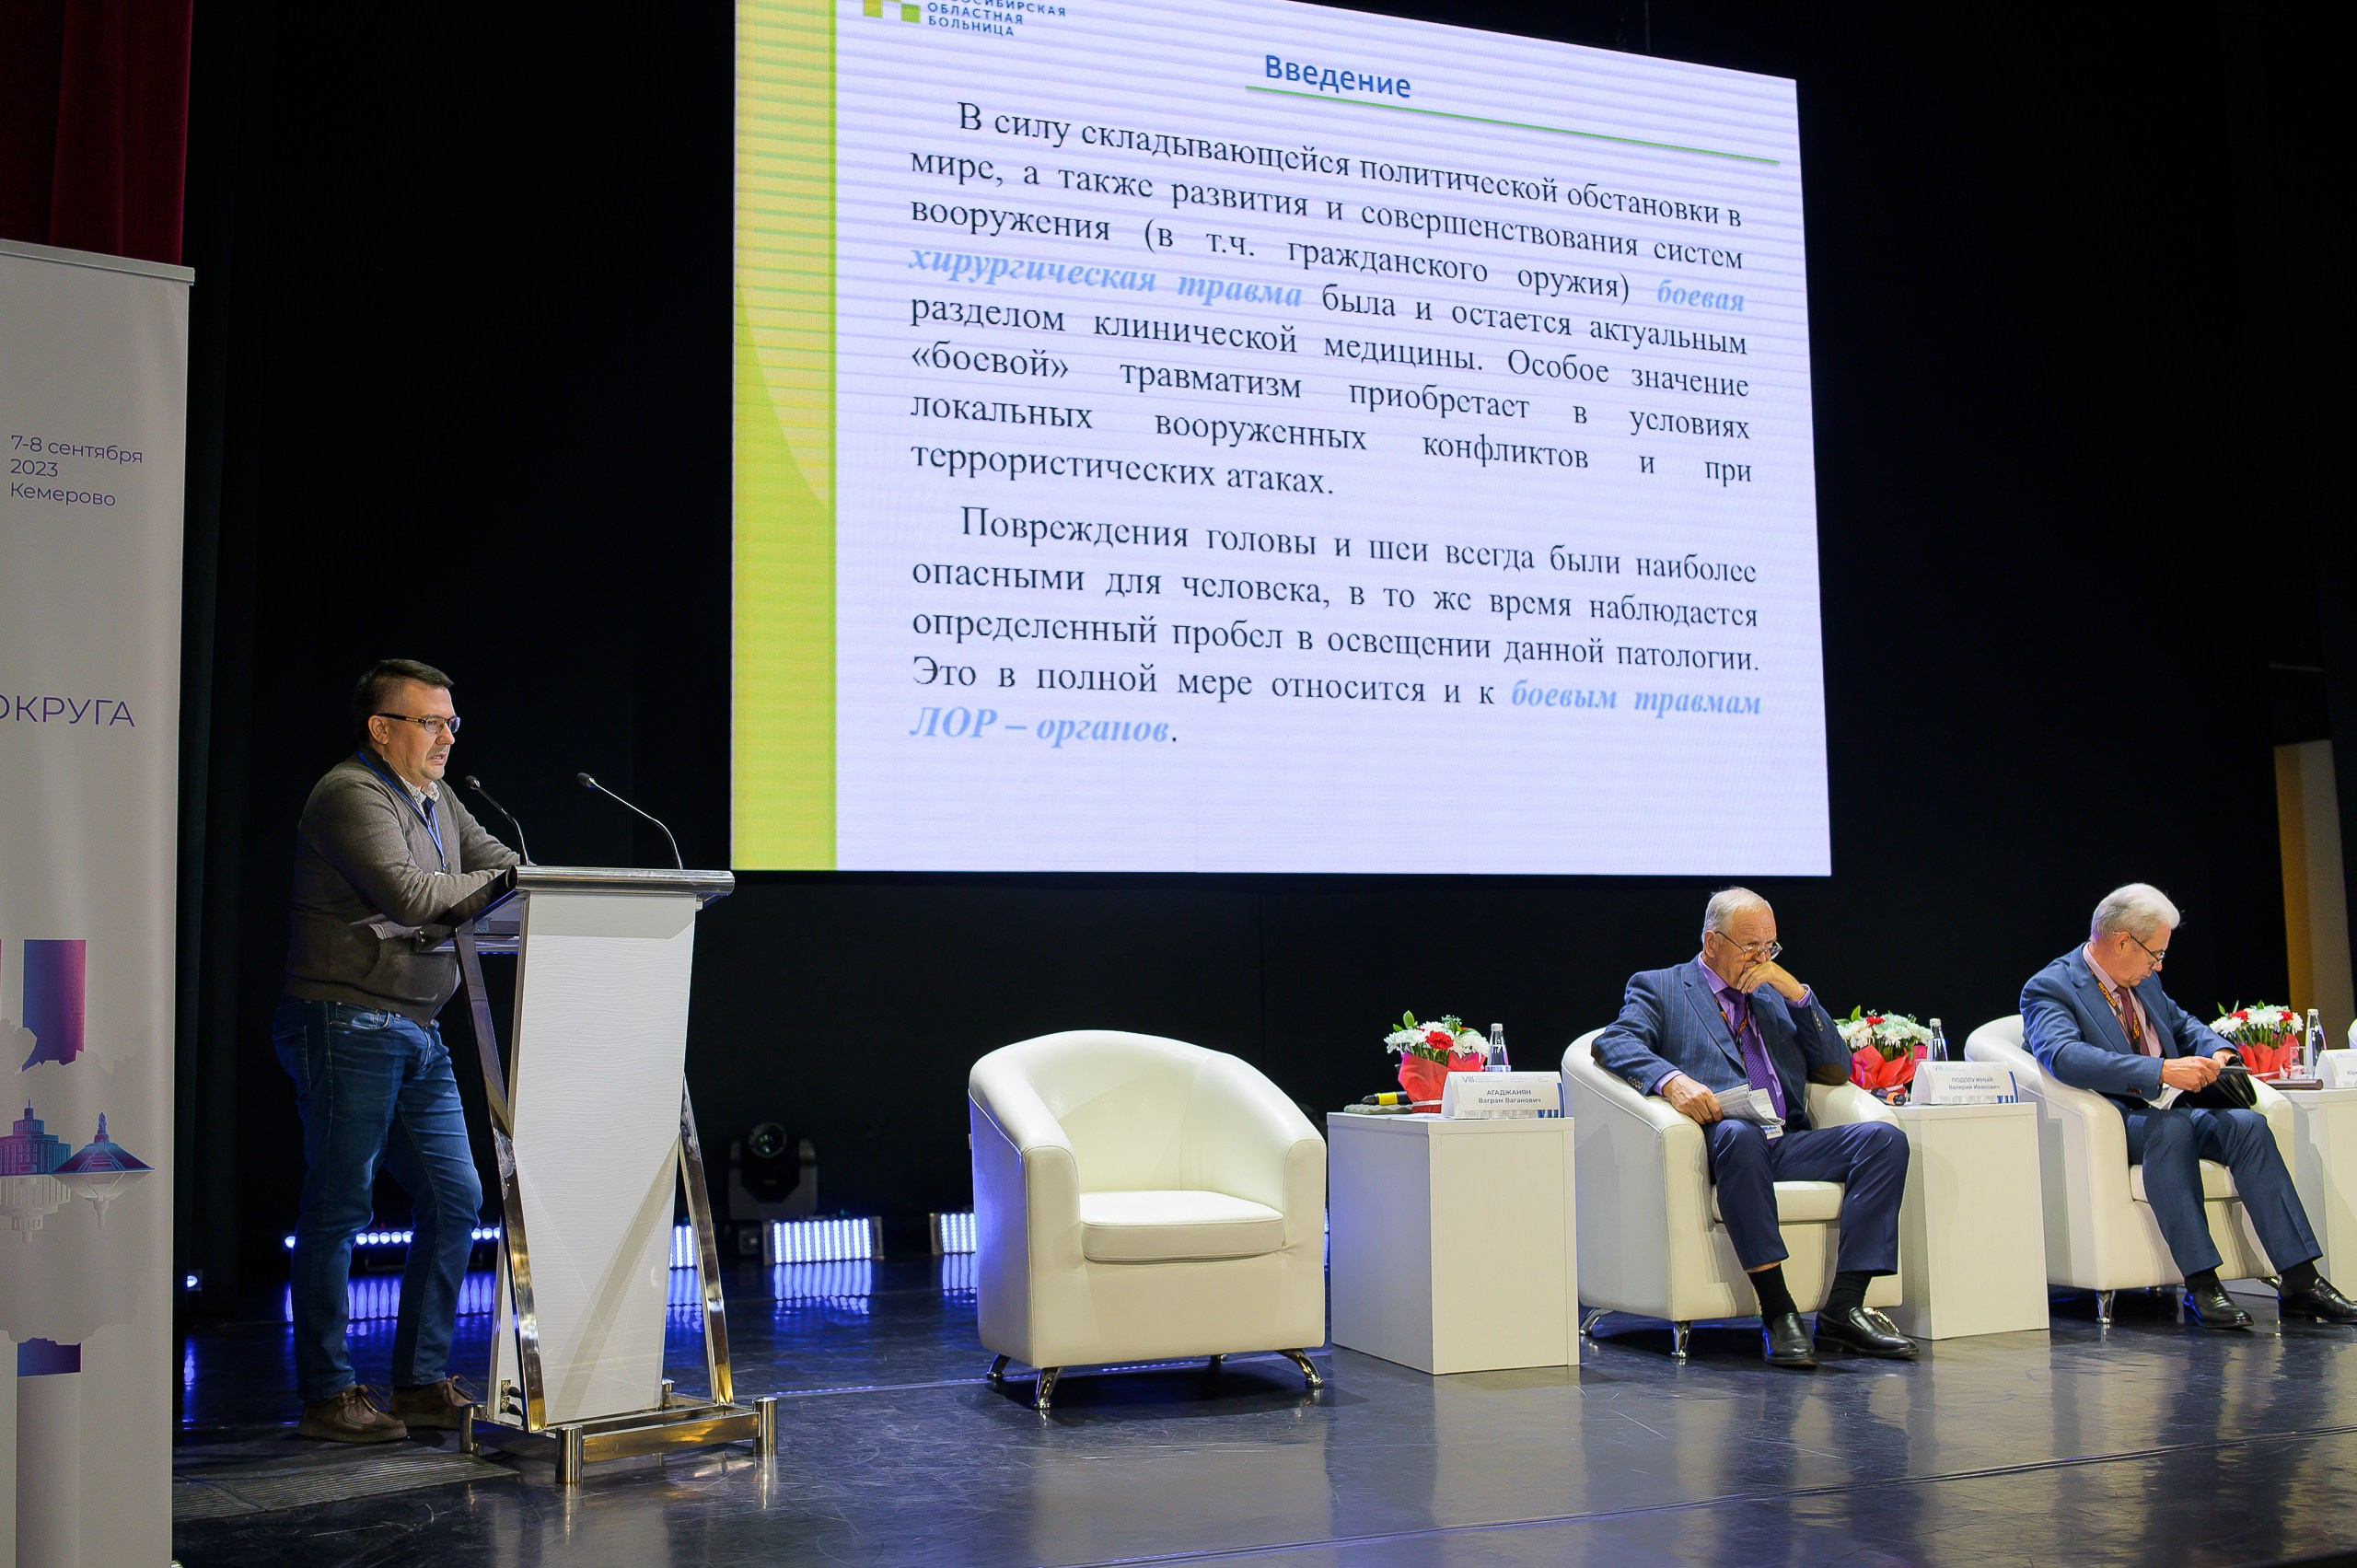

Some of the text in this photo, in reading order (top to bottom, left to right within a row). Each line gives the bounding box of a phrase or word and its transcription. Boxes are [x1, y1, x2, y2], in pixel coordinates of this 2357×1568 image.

[927, 2, 1024, 25] ОБЛАСТНАЯ
[928, 15, 1014, 36] БОЛЬНИЦА
[952, 0, 1066, 17] ИБИРСКАЯ
[1266, 54, 1411, 99] Введение
[958, 102, 1741, 226] В силу складывающейся политической обстановки в
[910, 153, 1742, 269] мире, а также развития и совершенствования систем
[911, 202, 1744, 311] вооружения (в т.ч. гражданского оружия) боевая
[909, 250, 1747, 354] хирургическая травма была и остается актуальным
[911, 299, 1748, 397] разделом клинической медицины. Особое значение
[912, 341, 1749, 439] «боевой» травматизм приобретает в условиях
[9, 459, 59, 478] 2023
[10, 434, 144, 464] 7-8 сентября
[911, 397, 1751, 487] локальных вооруженных конфликтов и при
[911, 447, 1332, 494] террористических атаках.
[10, 482, 116, 506] Кемерово
[961, 506, 1756, 582] Повреждения головы и шеи всегда были наиболее
[912, 563, 1757, 626] опасными для человека, в то же время наблюдается
[913, 614, 1758, 670] определенный пробел в освещении данной патологии.
[913, 656, 1759, 718] Это в полной мере относится и к боевым травмам
[910, 708, 997, 737] ЛОР
[1038, 721, 1176, 747] органов.
